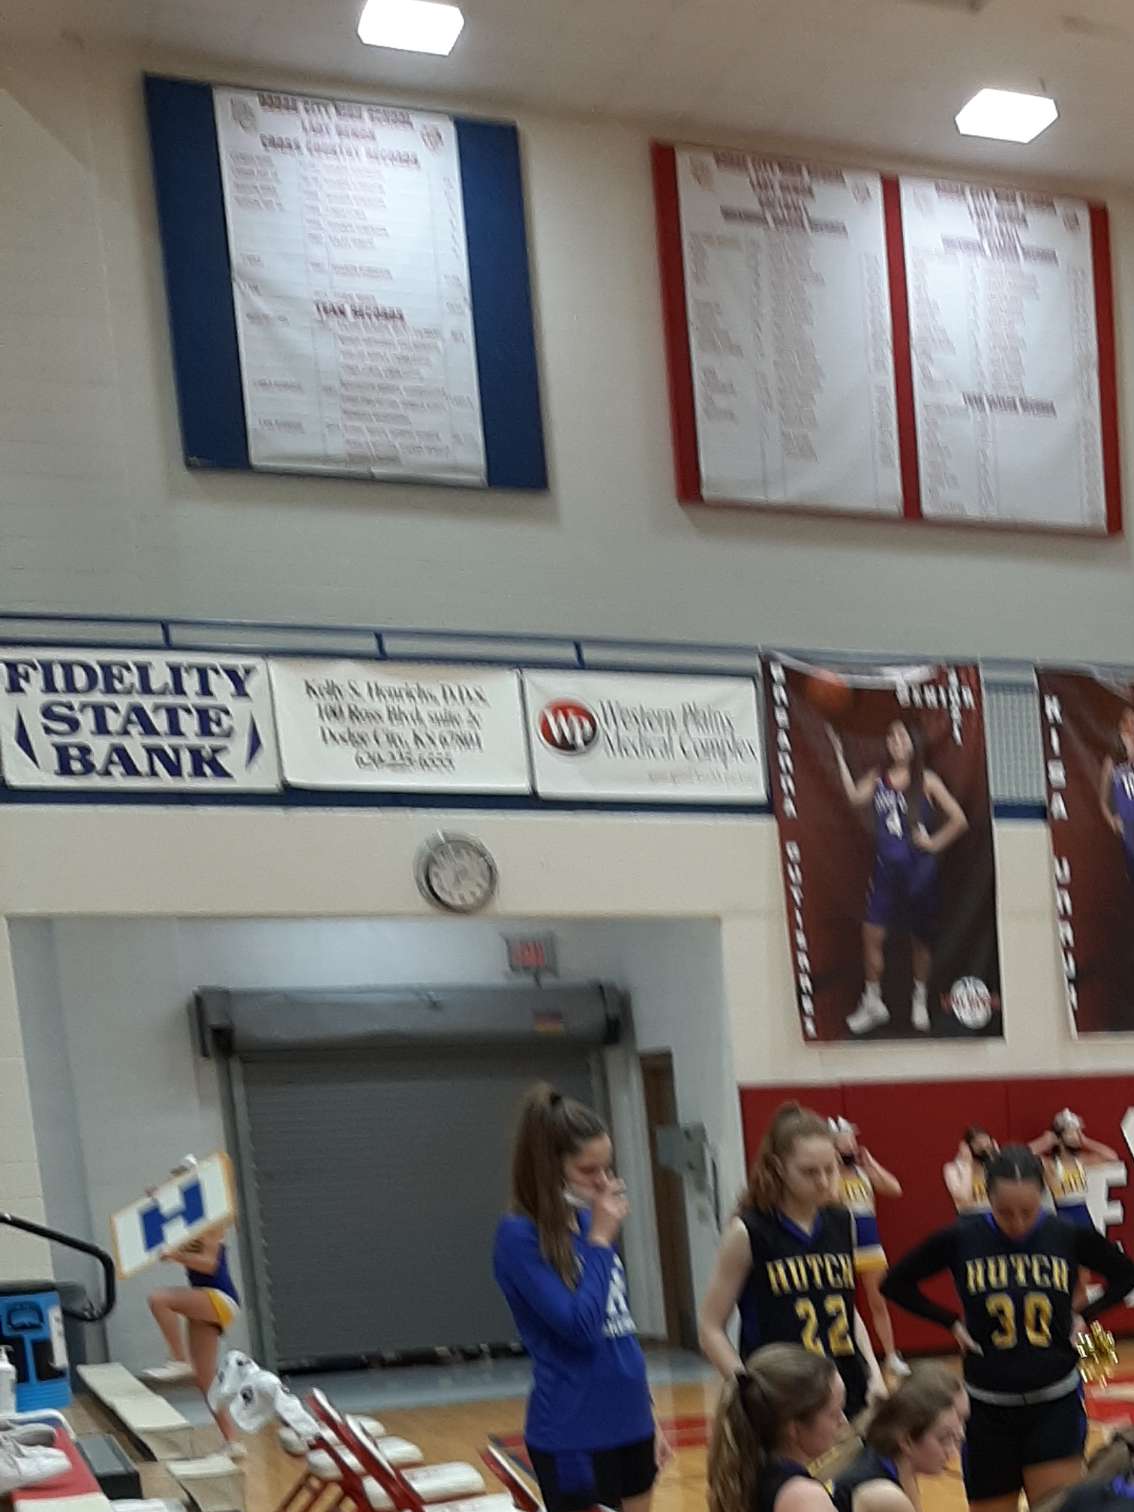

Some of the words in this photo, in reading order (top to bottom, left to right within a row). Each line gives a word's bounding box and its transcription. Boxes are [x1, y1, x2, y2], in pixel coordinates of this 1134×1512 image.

[2, 659, 257, 701] FIDELITY
[40, 701, 234, 738] STATE
[52, 742, 237, 780] BANK
[140, 1181, 206, 1253] H
[766, 1253, 855, 1296] HUTCH
[966, 1253, 1070, 1296] HUTCH
[795, 1294, 855, 1358] 22
[985, 1291, 1053, 1349] 30
